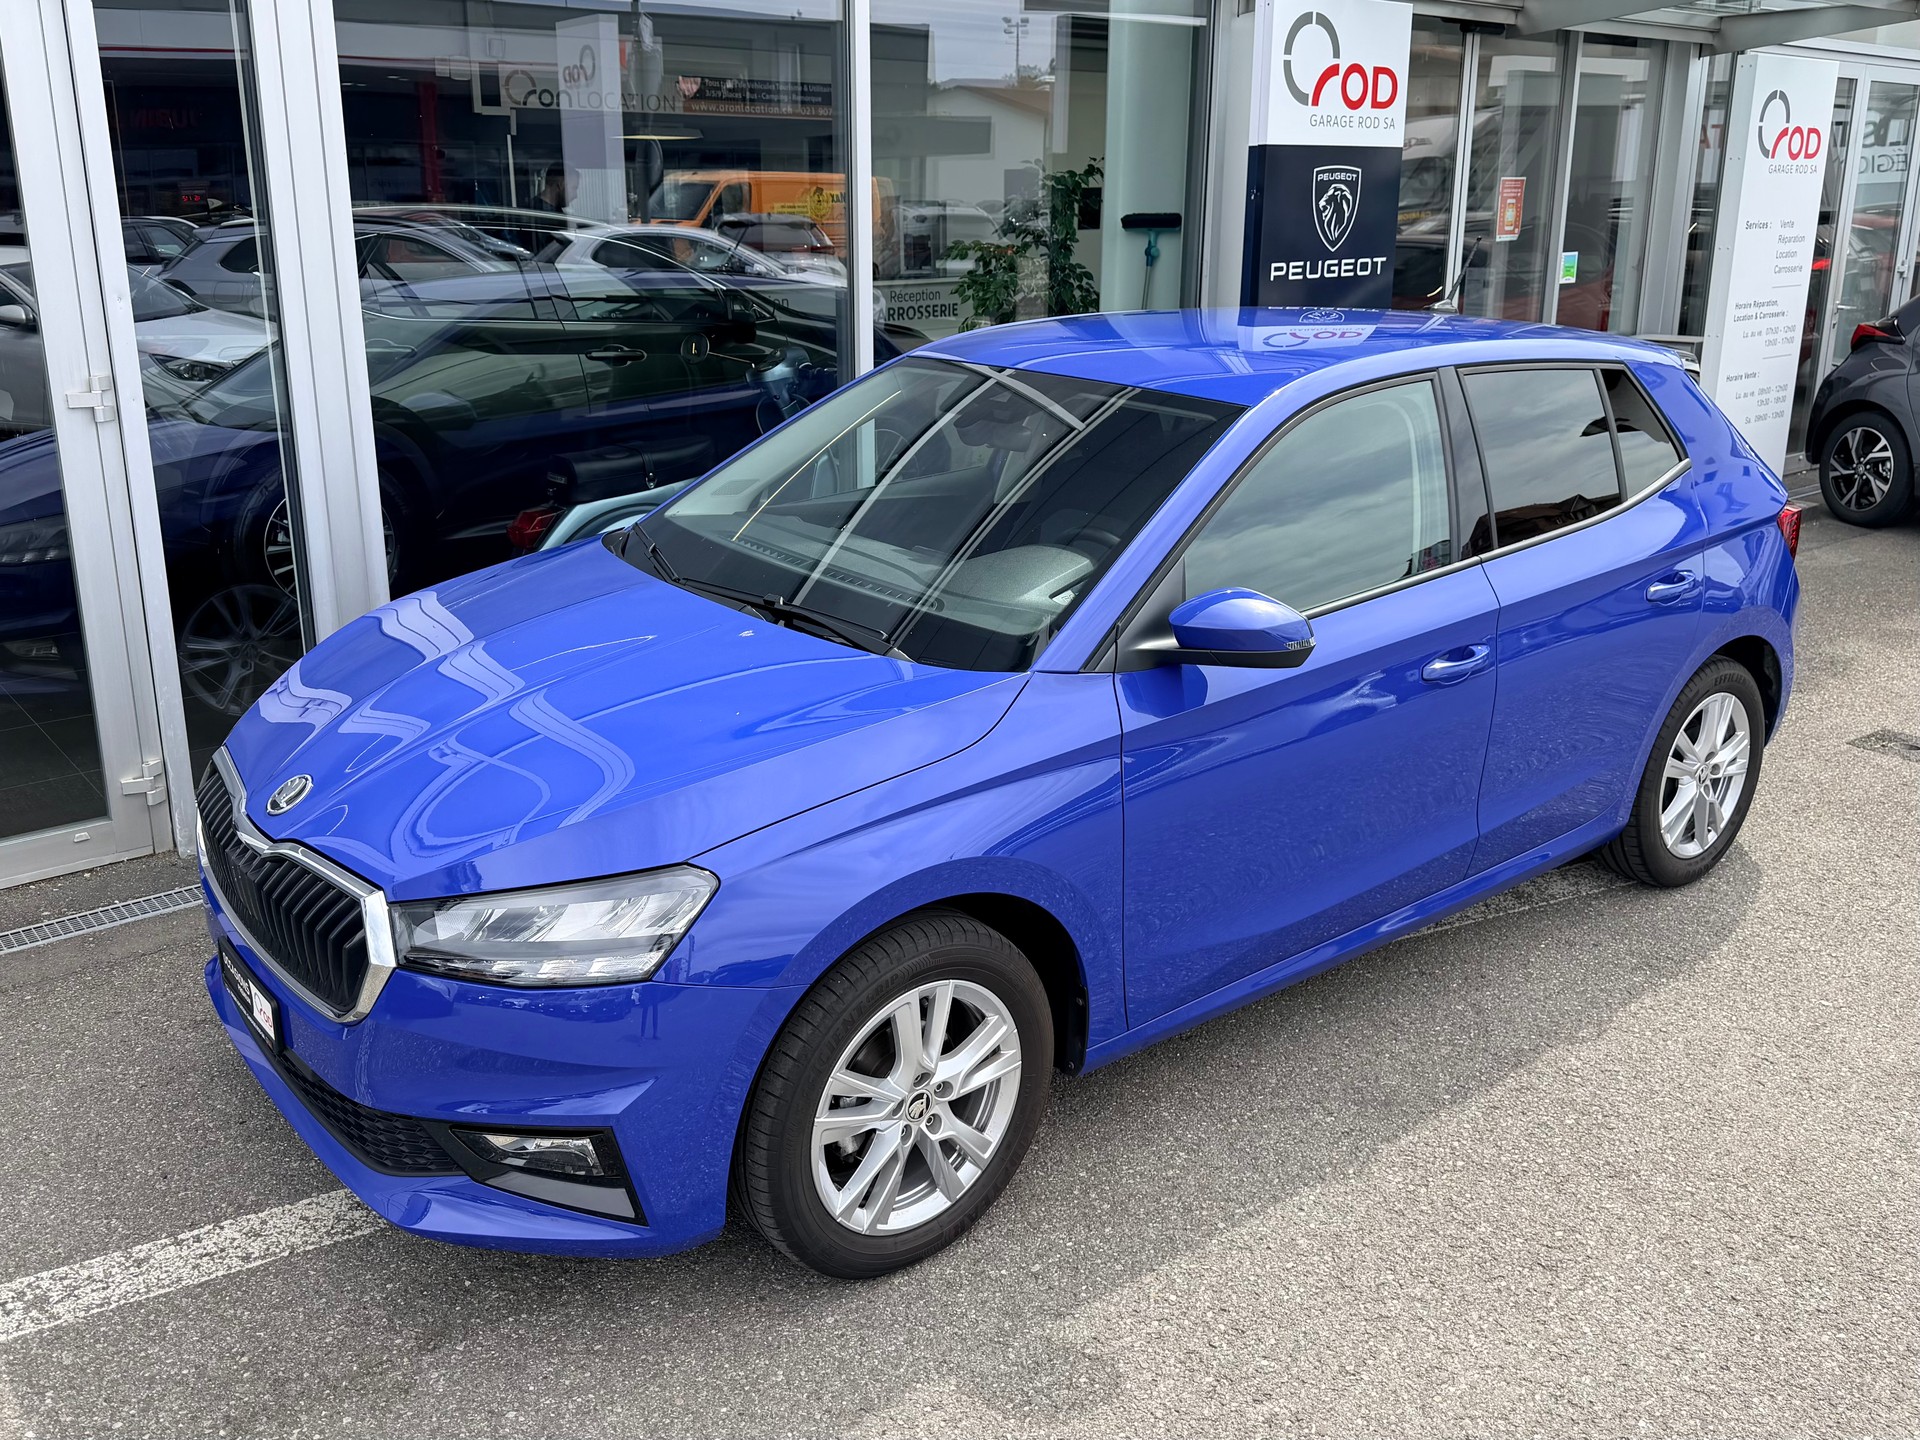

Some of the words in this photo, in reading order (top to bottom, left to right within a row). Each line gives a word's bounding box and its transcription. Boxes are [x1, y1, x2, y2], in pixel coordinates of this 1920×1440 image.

[577, 91, 676, 113] LOCATION
[1309, 113, 1354, 128] GARAGE
[1358, 116, 1380, 129] ROD
[1383, 117, 1396, 130] SA
[1768, 164, 1793, 174] GARAGE
[1795, 164, 1809, 174] ROD
[1809, 165, 1818, 174] SA
[1317, 172, 1358, 182] PEUGEOT
[1745, 220, 1769, 230] Services
[1780, 219, 1795, 229] Vente
[1777, 234, 1806, 245] Réparation
[1775, 249, 1798, 260] Location
[1270, 257, 1387, 282] PEUGEOT
[1773, 265, 1803, 275] Carrosserie
[889, 287, 942, 304] Réception
[1734, 302, 1752, 310] Horaire
[1733, 313, 1754, 323] Location
[1759, 310, 1785, 320] Carrosserie
[1726, 374, 1743, 383] Horaire
[1744, 371, 1757, 380] Vente
